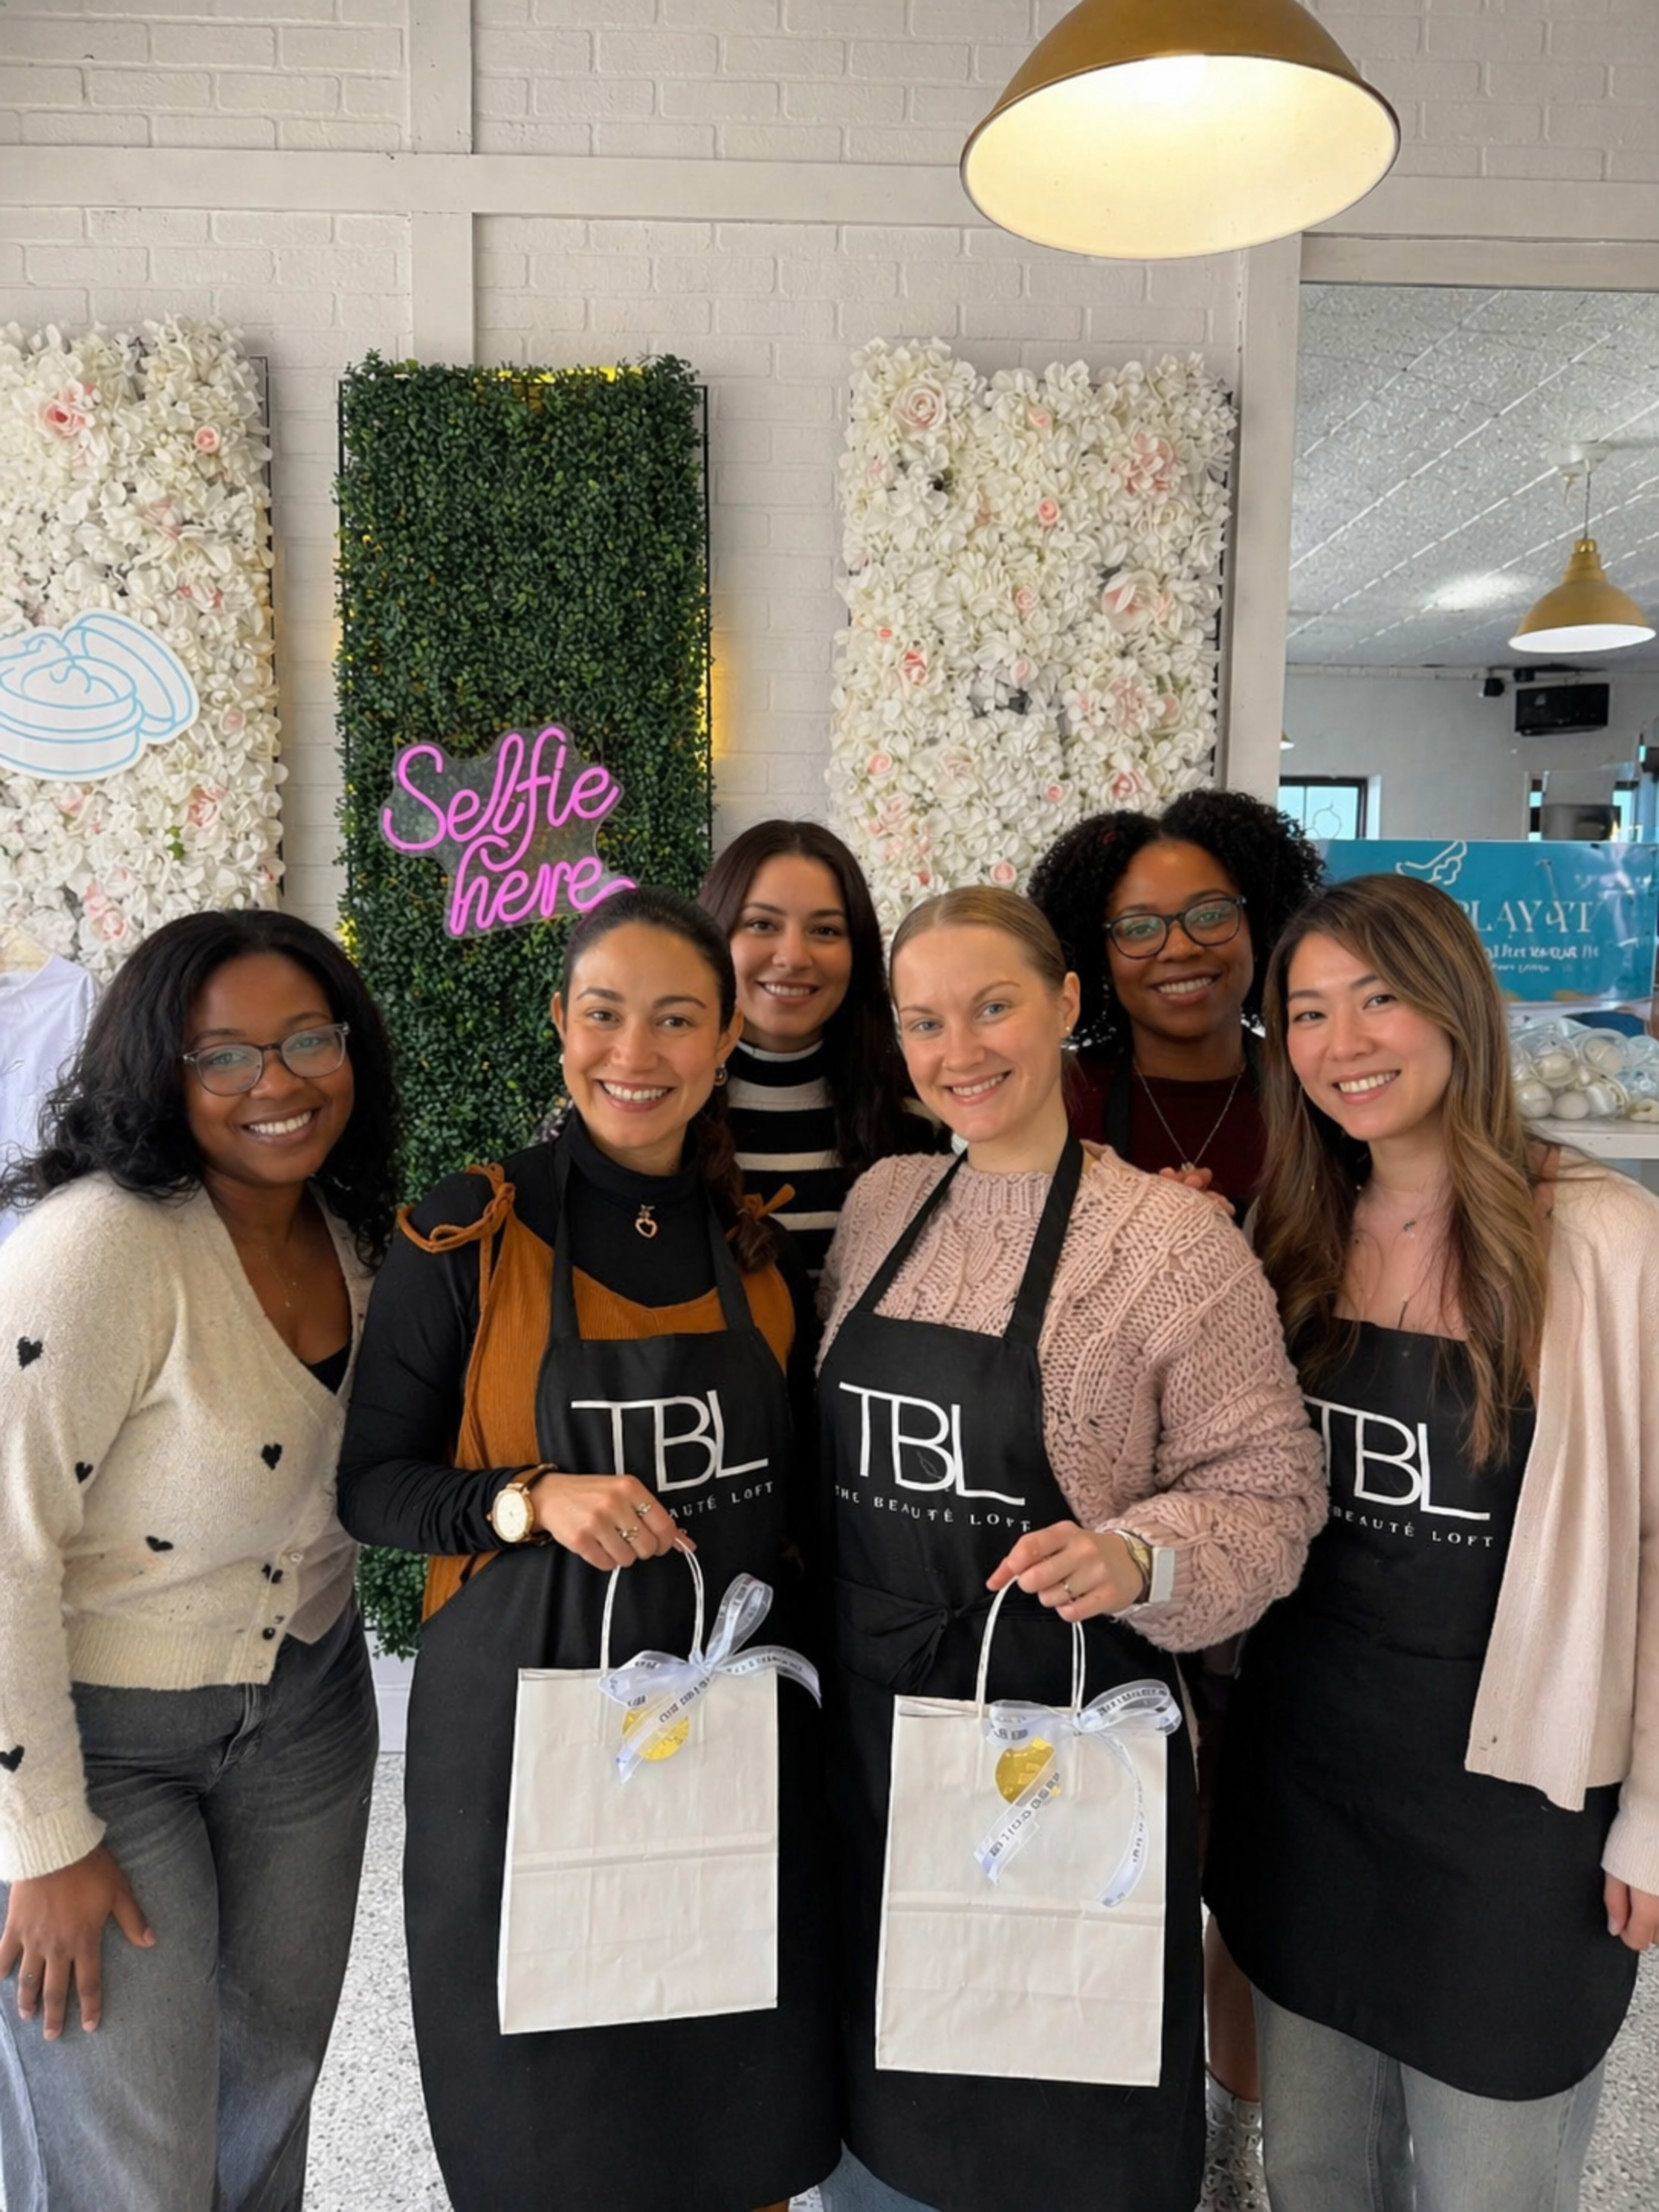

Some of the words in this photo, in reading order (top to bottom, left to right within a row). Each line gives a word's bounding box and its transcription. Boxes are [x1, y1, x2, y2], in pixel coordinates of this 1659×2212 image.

[383, 727, 621, 872] Selfie
[449, 835, 637, 936] here
[571, 1390, 769, 1492] TBL
[839, 1381, 1026, 1507] TBL
[1303, 1394, 1491, 1521] TBL
[670, 1494, 717, 1519] AUTÉ
[731, 1481, 773, 1504] LOFT
[874, 1497, 953, 1522] BEAUTÉ
[1333, 1506, 1415, 1537] BEAUTÉ
[1433, 1531, 1494, 1548] LOFT
